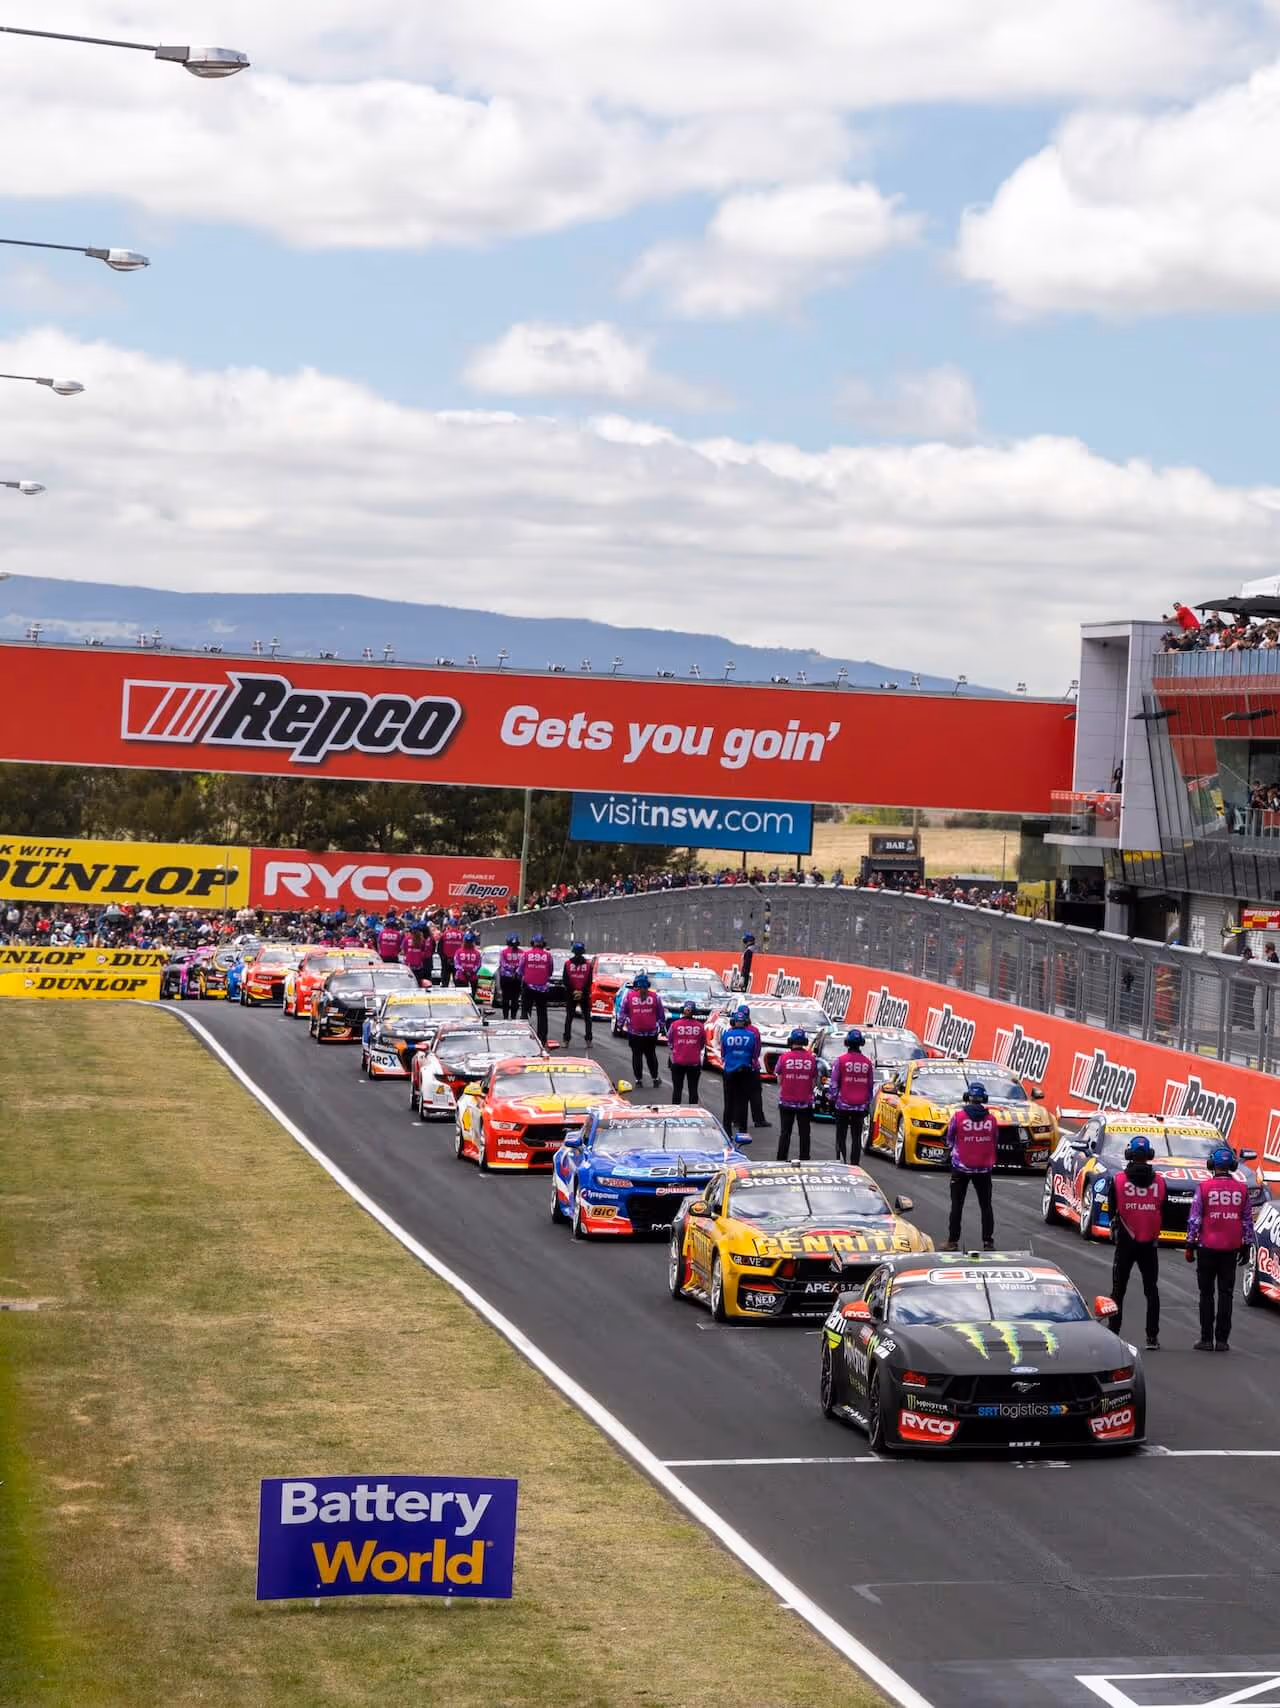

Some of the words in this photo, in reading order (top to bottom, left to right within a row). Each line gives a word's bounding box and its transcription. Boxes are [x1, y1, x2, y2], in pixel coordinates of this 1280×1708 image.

[201, 672, 463, 763] Repco
[500, 705, 614, 751] Gets
[623, 722, 714, 764] you
[590, 796, 794, 834] visitnsw.com
[19, 845, 72, 858] WITH
[885, 840, 905, 850] BAR
[264, 861, 434, 902] RYCO
[466, 882, 510, 899] Repco
[36, 977, 147, 991] DUNLOP
[819, 975, 853, 1021] Repco
[874, 985, 909, 1028] Repco
[939, 1003, 976, 1059] Repco
[726, 1036, 750, 1048] 007
[1006, 1024, 1051, 1083] Repco
[785, 1058, 812, 1071] 253
[919, 1067, 993, 1076] Steadfast
[1084, 1048, 1136, 1112] Repco
[1177, 1075, 1237, 1140] Repco
[1107, 1125, 1164, 1135] NATIONAL
[751, 1167, 820, 1176] PENRITE
[740, 1174, 842, 1188] Steadfast
[1207, 1190, 1242, 1206] 266
[757, 1233, 912, 1257] PENRITE
[733, 1255, 762, 1267] GROVE
[964, 1269, 1026, 1281] ENZED
[804, 1281, 838, 1294] APEX
[999, 1283, 1037, 1292] Waters
[844, 1310, 872, 1319] RYCO
[916, 1399, 949, 1411] MONSTER
[902, 1411, 956, 1435] RYCO
[1090, 1409, 1132, 1433] RYCO
[280, 1482, 493, 1537] Battery
[311, 1538, 486, 1585] World
